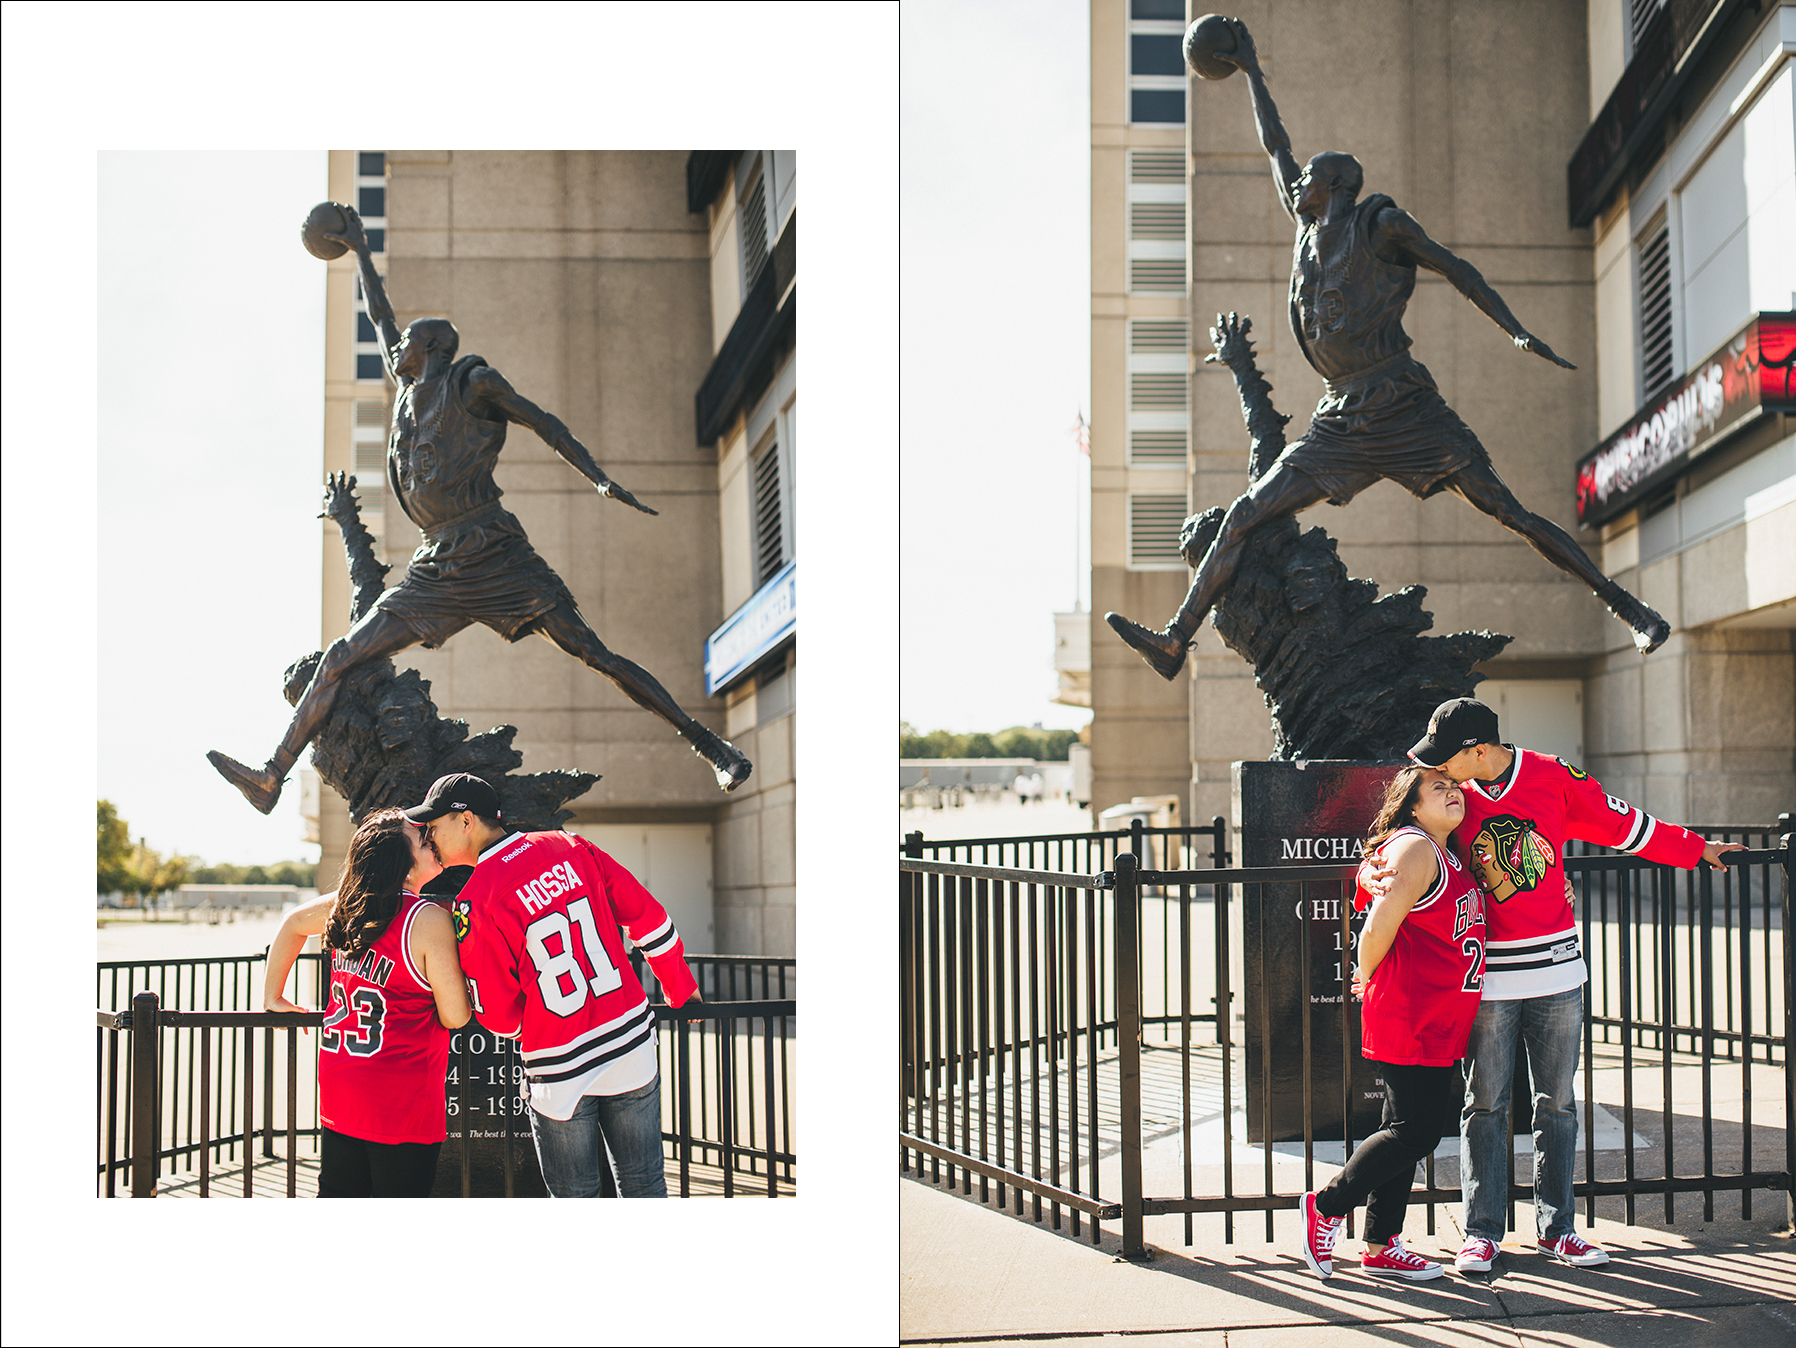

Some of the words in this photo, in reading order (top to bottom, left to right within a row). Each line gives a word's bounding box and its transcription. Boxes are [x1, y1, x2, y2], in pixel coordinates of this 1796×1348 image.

[501, 842, 533, 863] Reebok
[515, 860, 583, 916] HOSSA
[525, 894, 623, 1019] 81
[1461, 937, 1486, 992] 2
[320, 980, 387, 1057] 23
[469, 1129, 483, 1138] The
[484, 1129, 499, 1138] best
